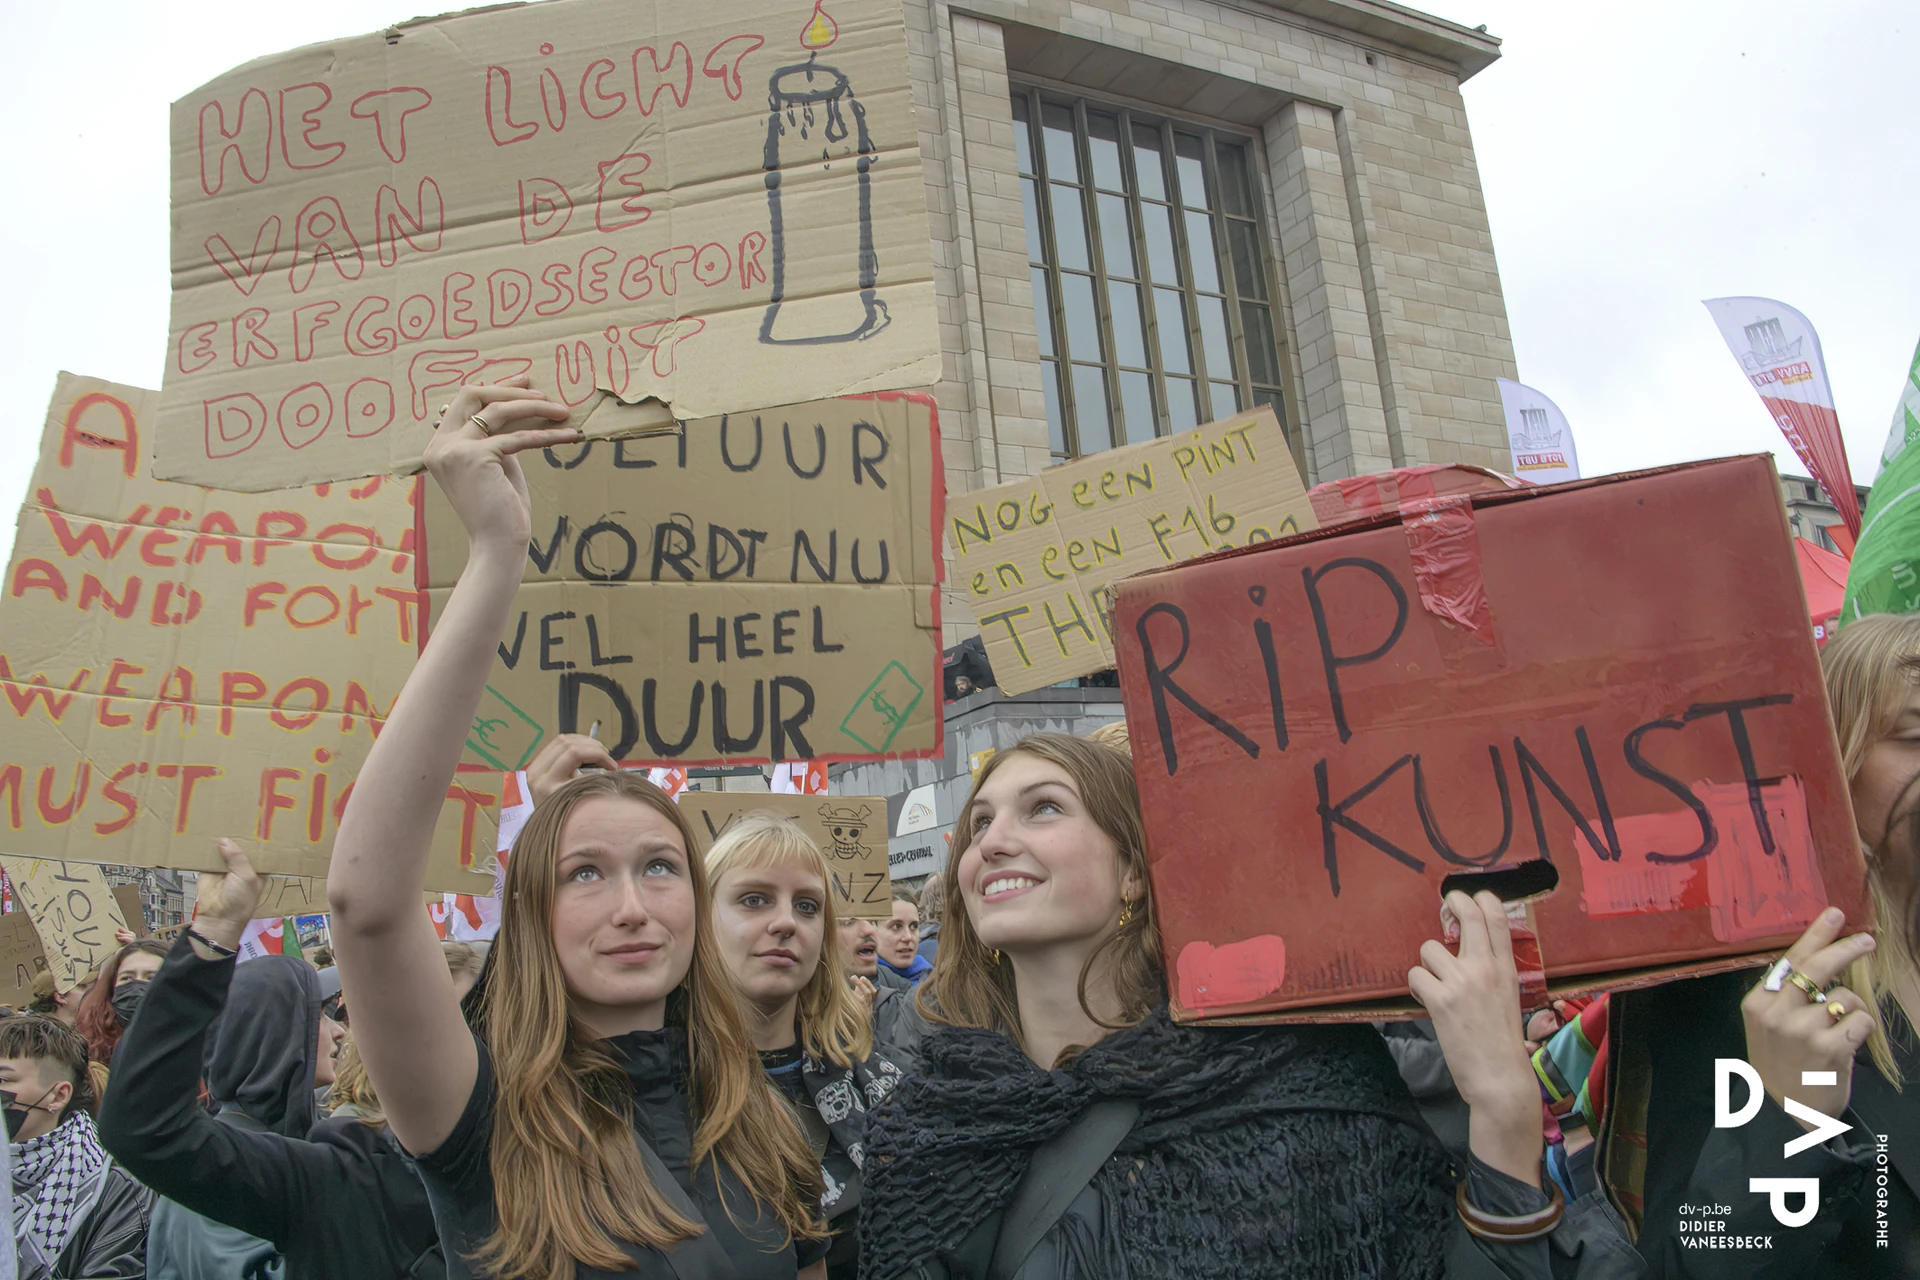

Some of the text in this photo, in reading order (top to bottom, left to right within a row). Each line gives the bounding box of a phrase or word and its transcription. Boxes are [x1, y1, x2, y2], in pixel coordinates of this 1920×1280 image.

[198, 81, 433, 196] HET
[203, 153, 652, 297] VAN DE
[177, 231, 768, 374] ERFGOEDSECTOR
[791, 528, 890, 585] NU
[952, 495, 1055, 556] NOG
[1147, 493, 1239, 562] F16
[11, 557, 203, 627] AND
[688, 605, 844, 664] HEEL
[558, 672, 816, 760] DUUR
[1313, 692, 1796, 899] KUNST
